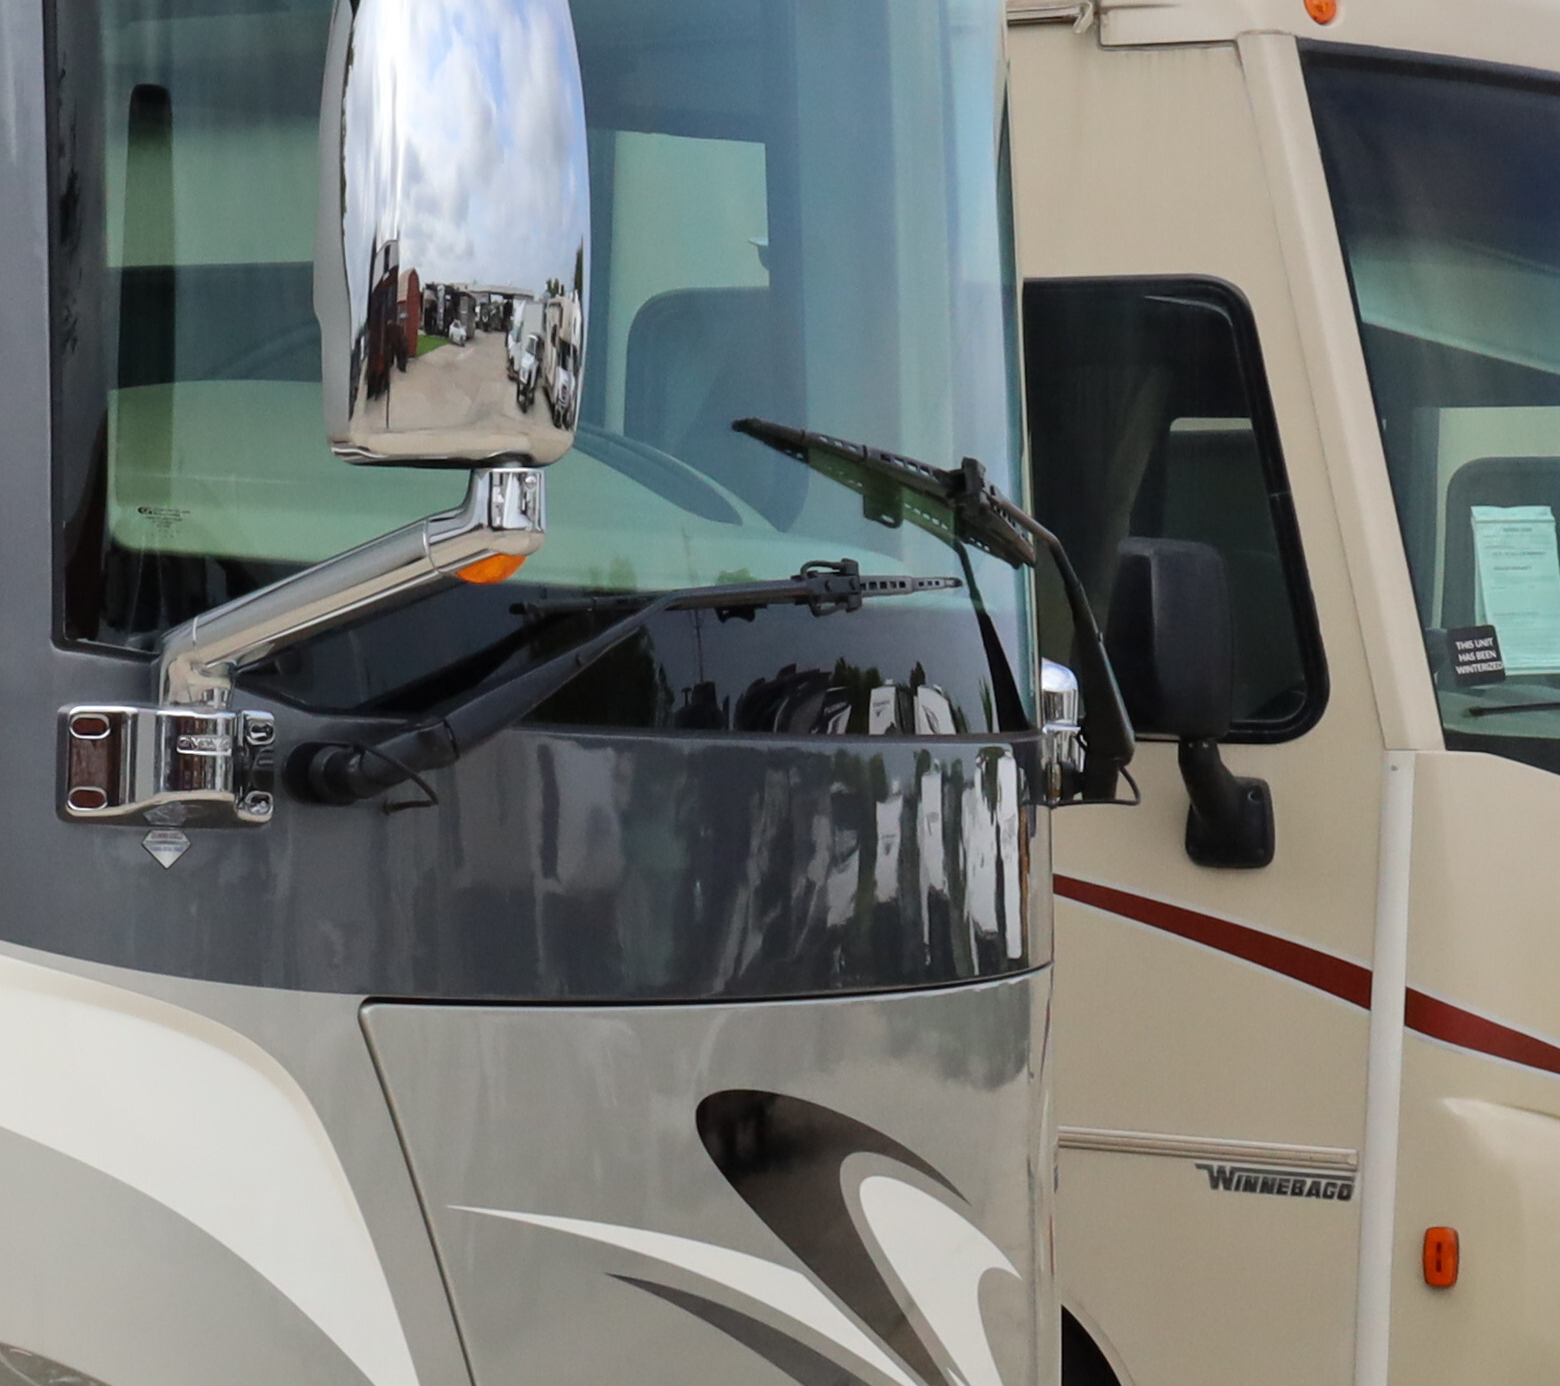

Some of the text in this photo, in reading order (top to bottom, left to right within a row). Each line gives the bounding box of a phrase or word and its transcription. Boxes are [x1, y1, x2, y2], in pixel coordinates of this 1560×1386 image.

[1455, 637, 1493, 650] THIS UNIT
[1458, 650, 1497, 662] HAS BEEN
[1455, 661, 1504, 674] WINTERIZED
[1195, 1163, 1357, 1202] WINNEBAGO
